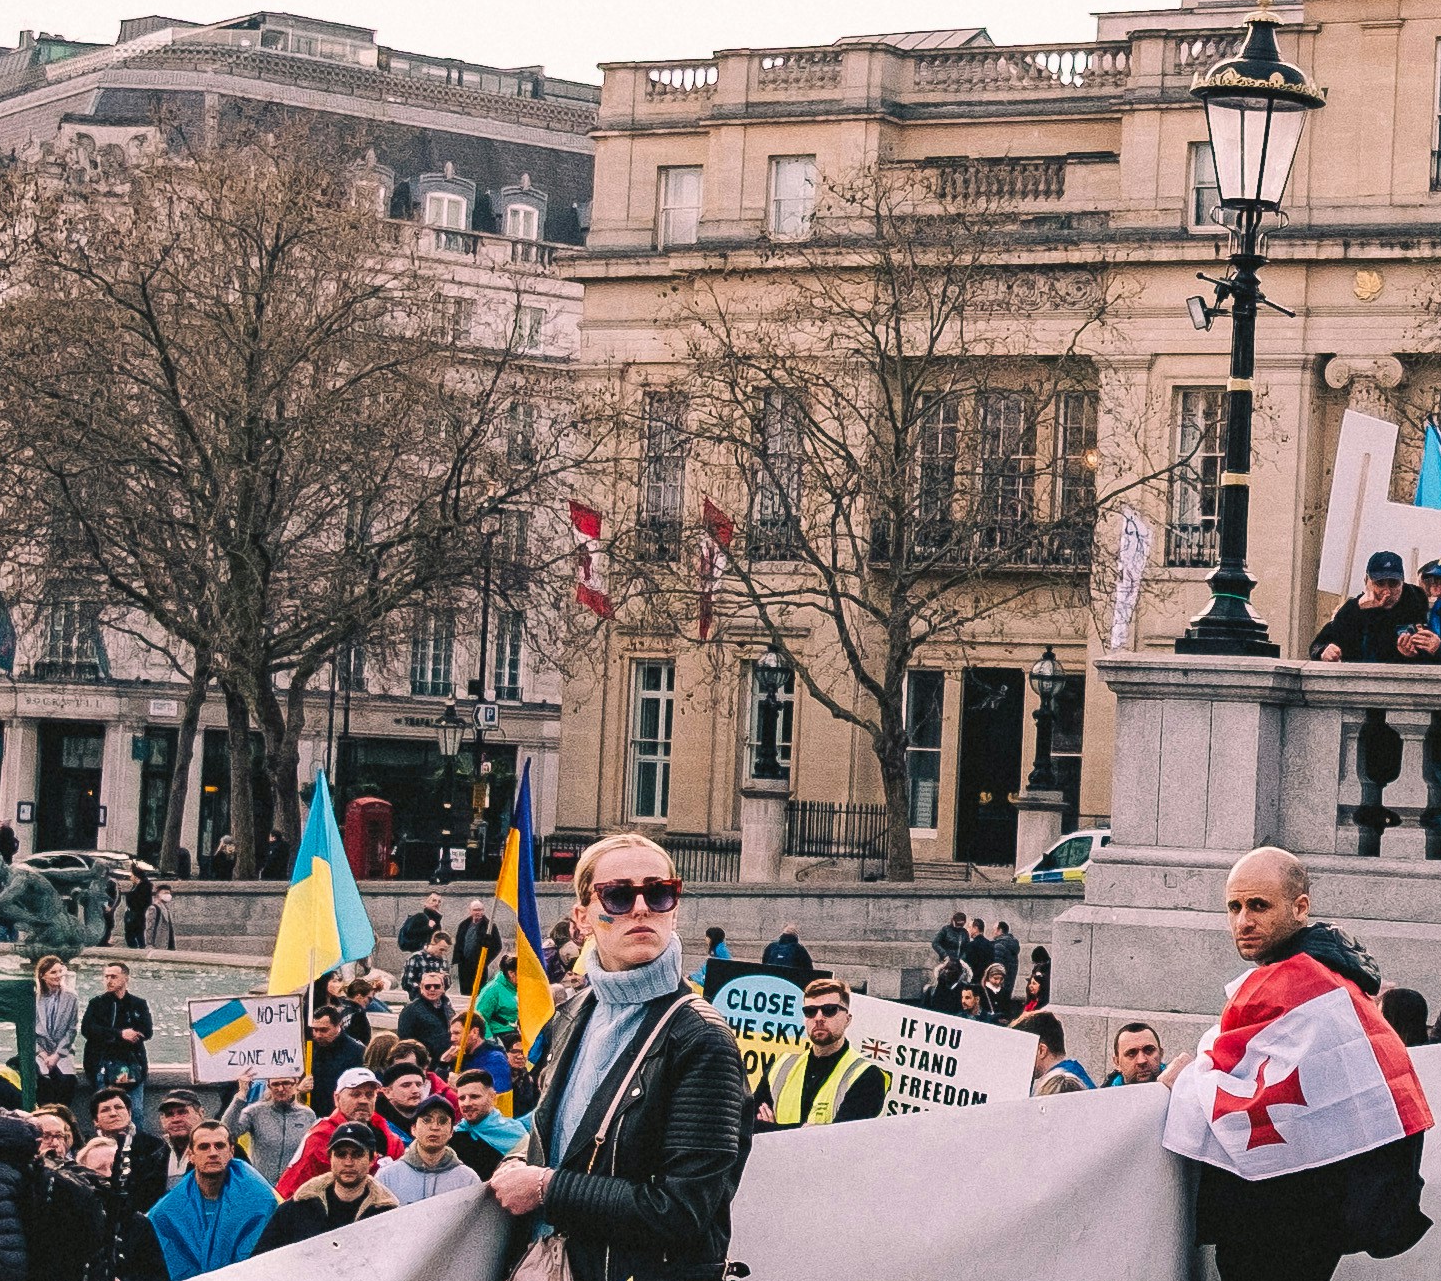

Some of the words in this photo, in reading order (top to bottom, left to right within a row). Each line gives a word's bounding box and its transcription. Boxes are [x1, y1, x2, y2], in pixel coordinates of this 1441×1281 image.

[257, 1004, 299, 1025] NO-FLY
[727, 988, 797, 1017] CLOSE
[724, 1016, 757, 1040] HE
[900, 1017, 918, 1039] IF
[924, 1022, 962, 1049] YOU
[227, 1049, 266, 1066] ZONE
[895, 1045, 958, 1077] STAND
[899, 1074, 988, 1107] FREEDOM
